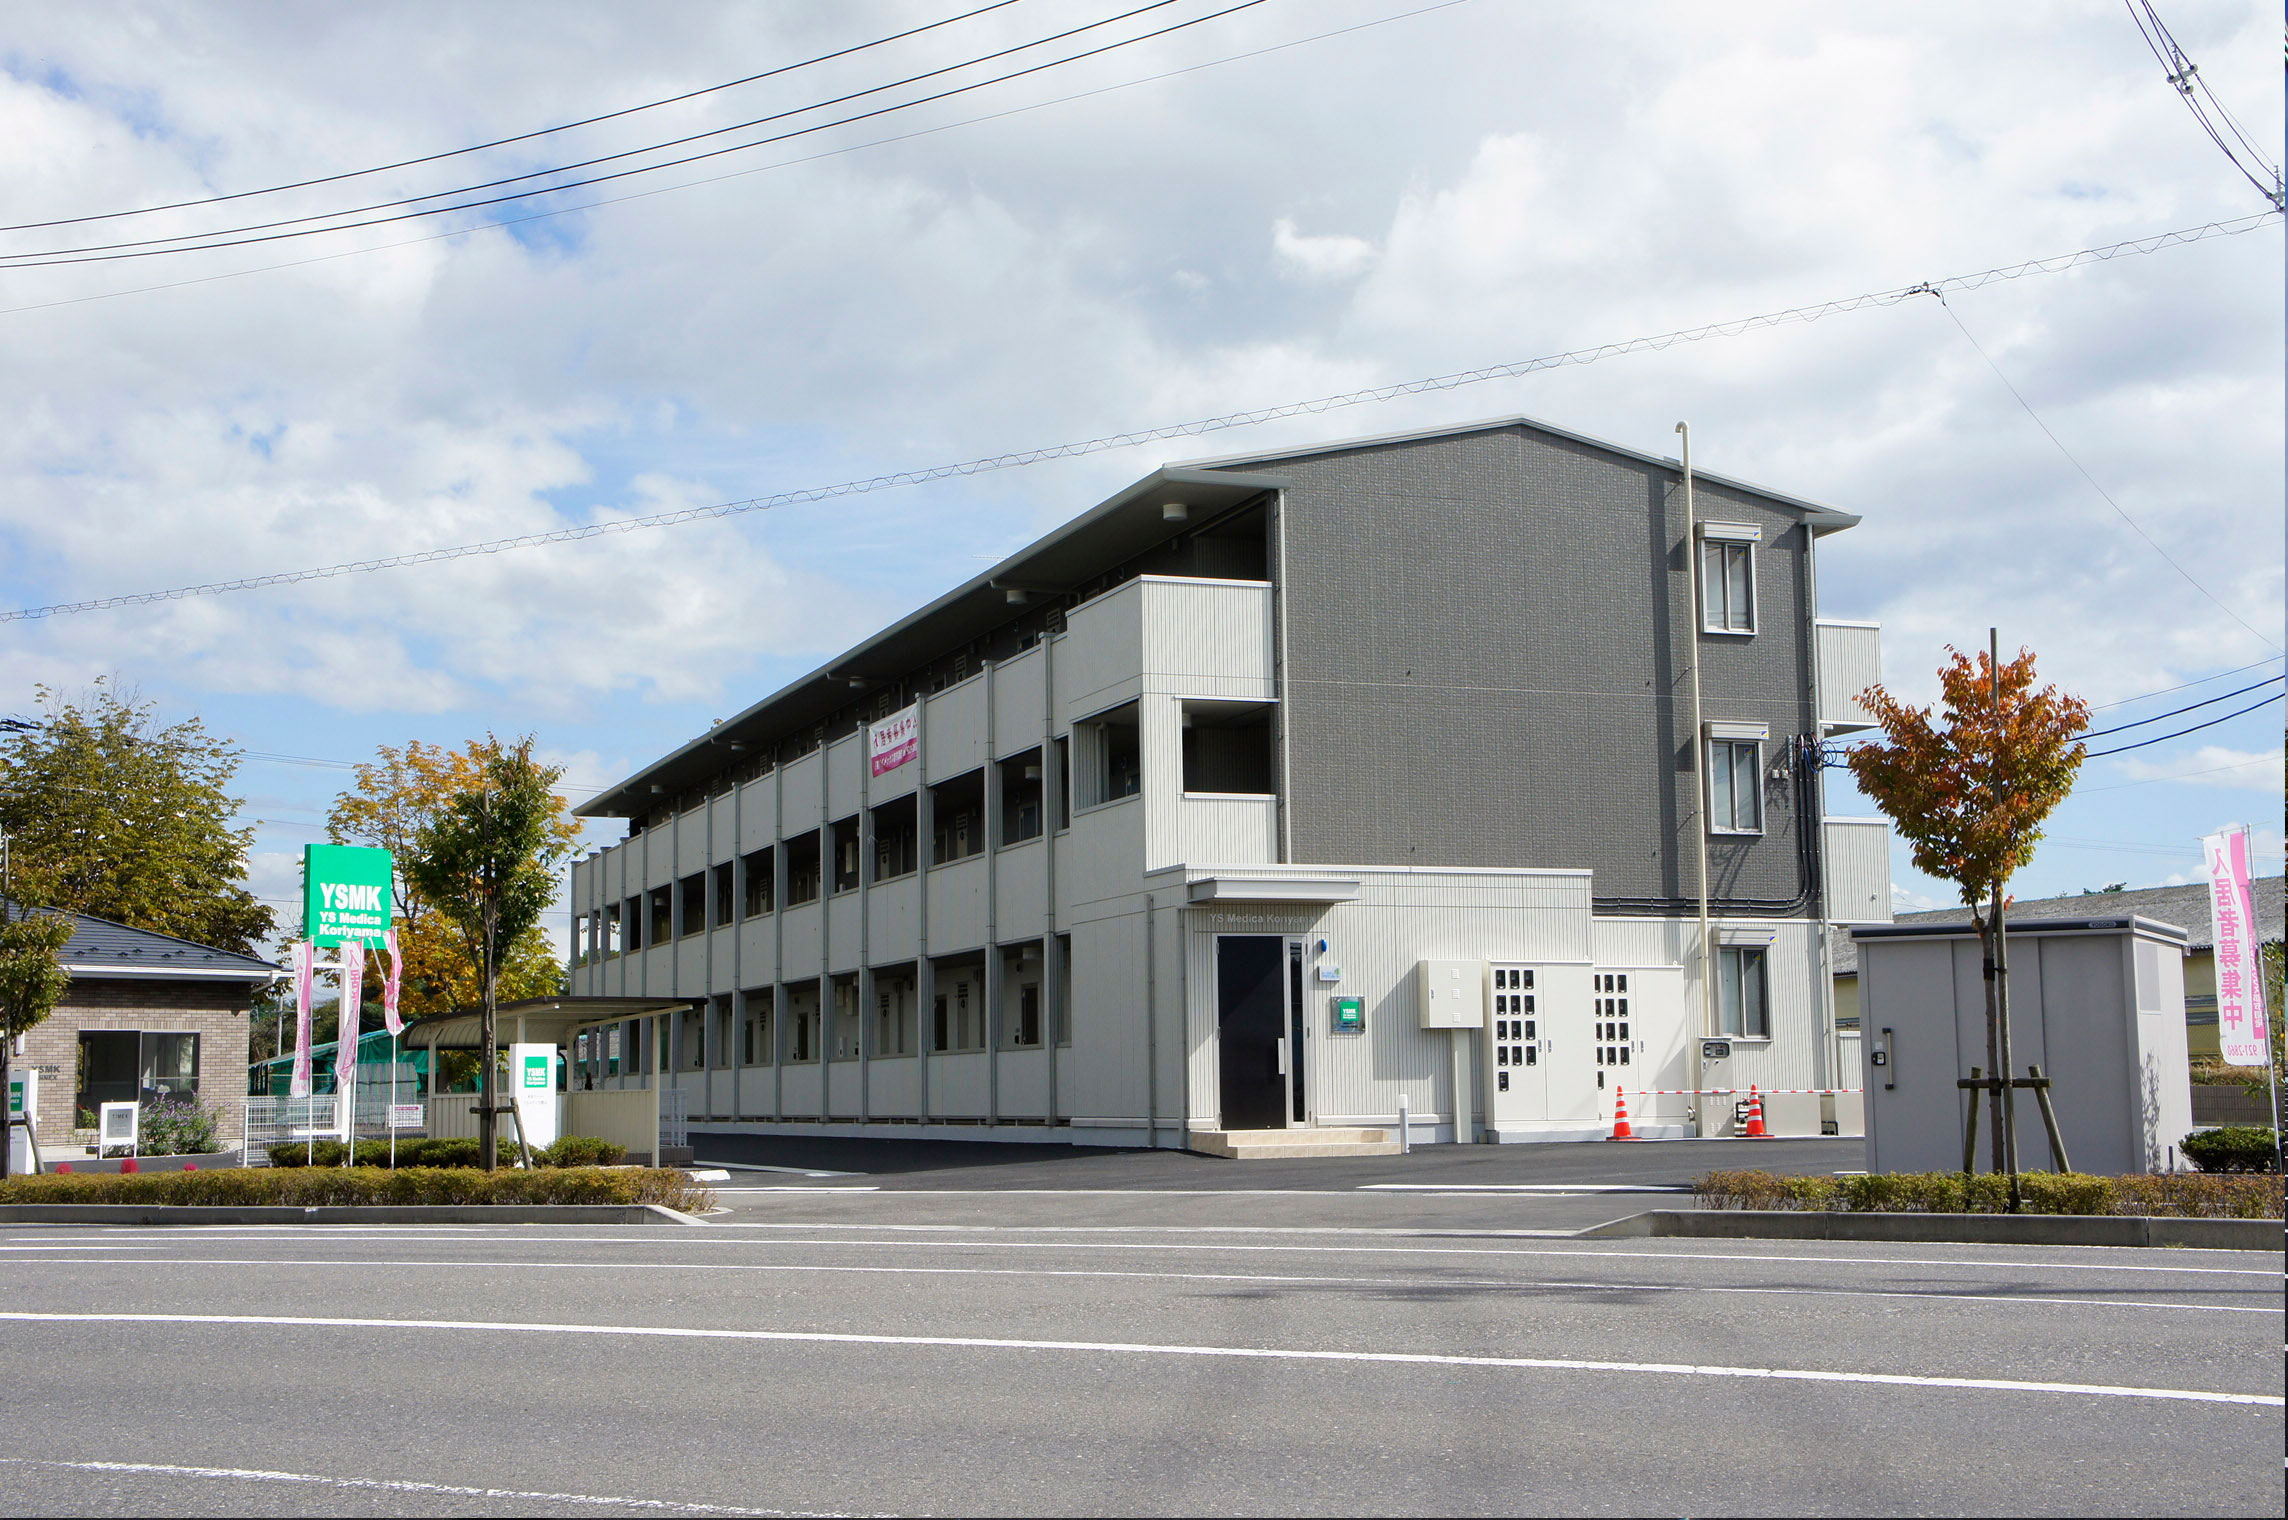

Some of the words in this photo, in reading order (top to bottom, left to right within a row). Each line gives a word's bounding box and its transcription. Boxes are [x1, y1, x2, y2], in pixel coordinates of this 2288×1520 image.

[320, 883, 382, 911] YSMK
[320, 911, 336, 922] YS
[339, 912, 381, 925] Medica
[1210, 914, 1224, 923] YS
[1227, 913, 1263, 923] Medica
[320, 924, 381, 938] Koriyama
